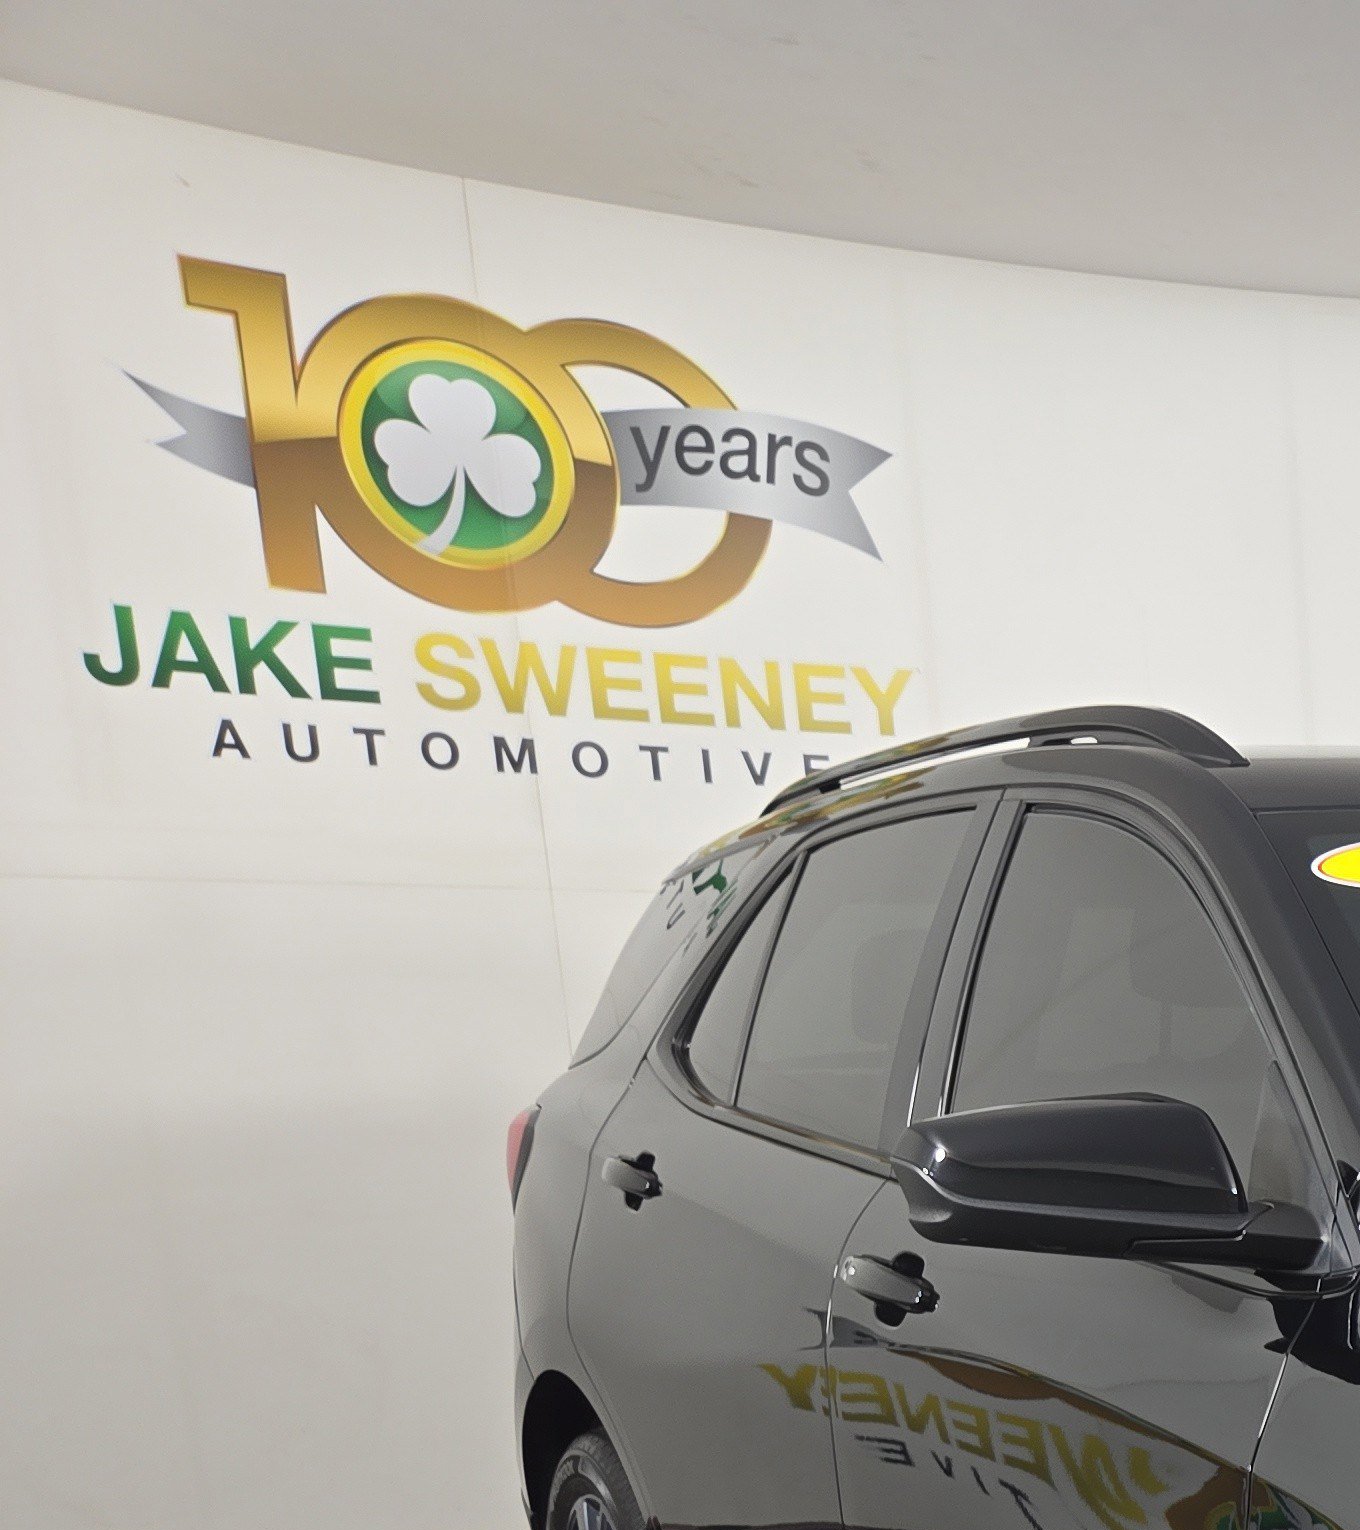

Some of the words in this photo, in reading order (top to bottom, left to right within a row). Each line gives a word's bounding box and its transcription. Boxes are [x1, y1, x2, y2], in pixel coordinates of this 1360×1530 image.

[177, 252, 773, 628] 100
[630, 421, 831, 497] years
[82, 603, 381, 704] JAKE
[414, 632, 914, 736] SWEENEY
